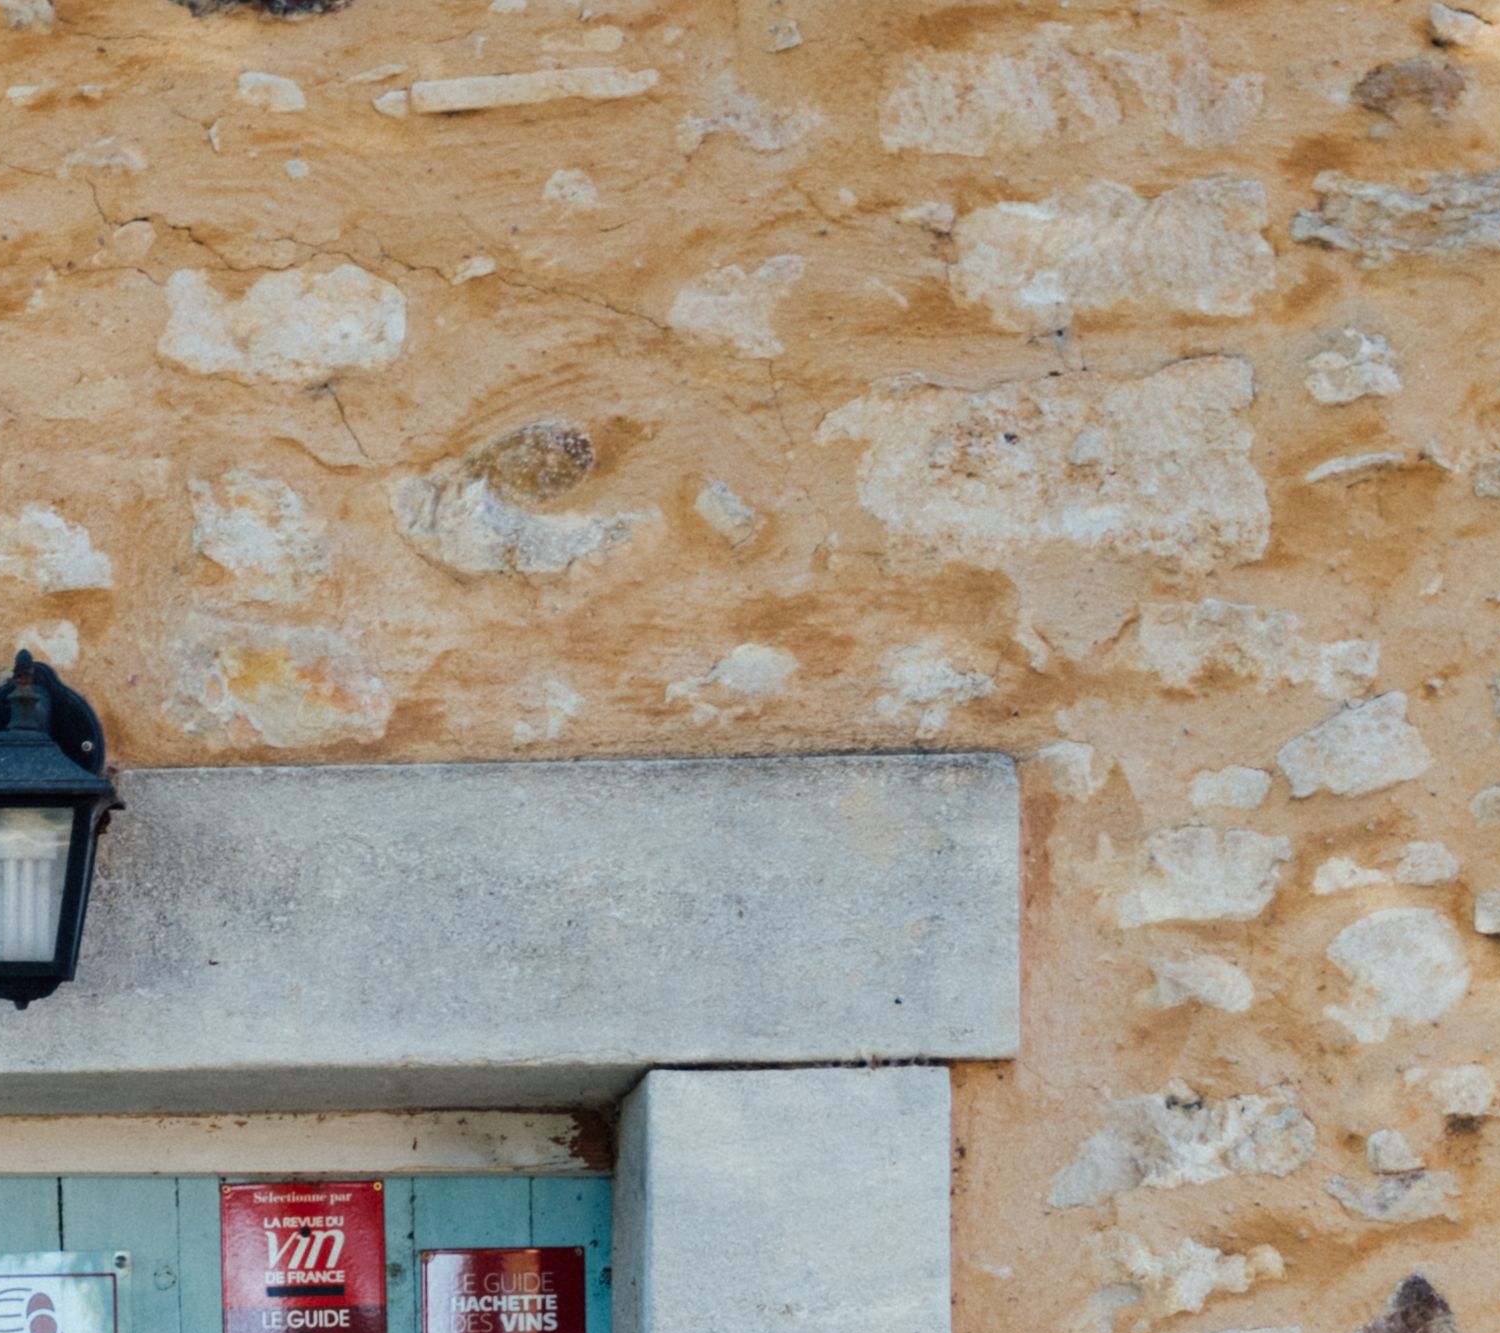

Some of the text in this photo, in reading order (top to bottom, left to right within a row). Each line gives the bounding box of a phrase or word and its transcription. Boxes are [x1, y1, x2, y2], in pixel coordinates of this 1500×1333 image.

[330, 1192, 352, 1205] par
[264, 1217, 343, 1228] LA REVUE DU
[266, 1227, 344, 1269] vin
[266, 1271, 344, 1283] DE FRANCE
[484, 1272, 554, 1293] GUIDE
[452, 1295, 557, 1312] HACHETTE
[263, 1310, 350, 1328] LE GUIDE
[500, 1313, 557, 1332] VINS
